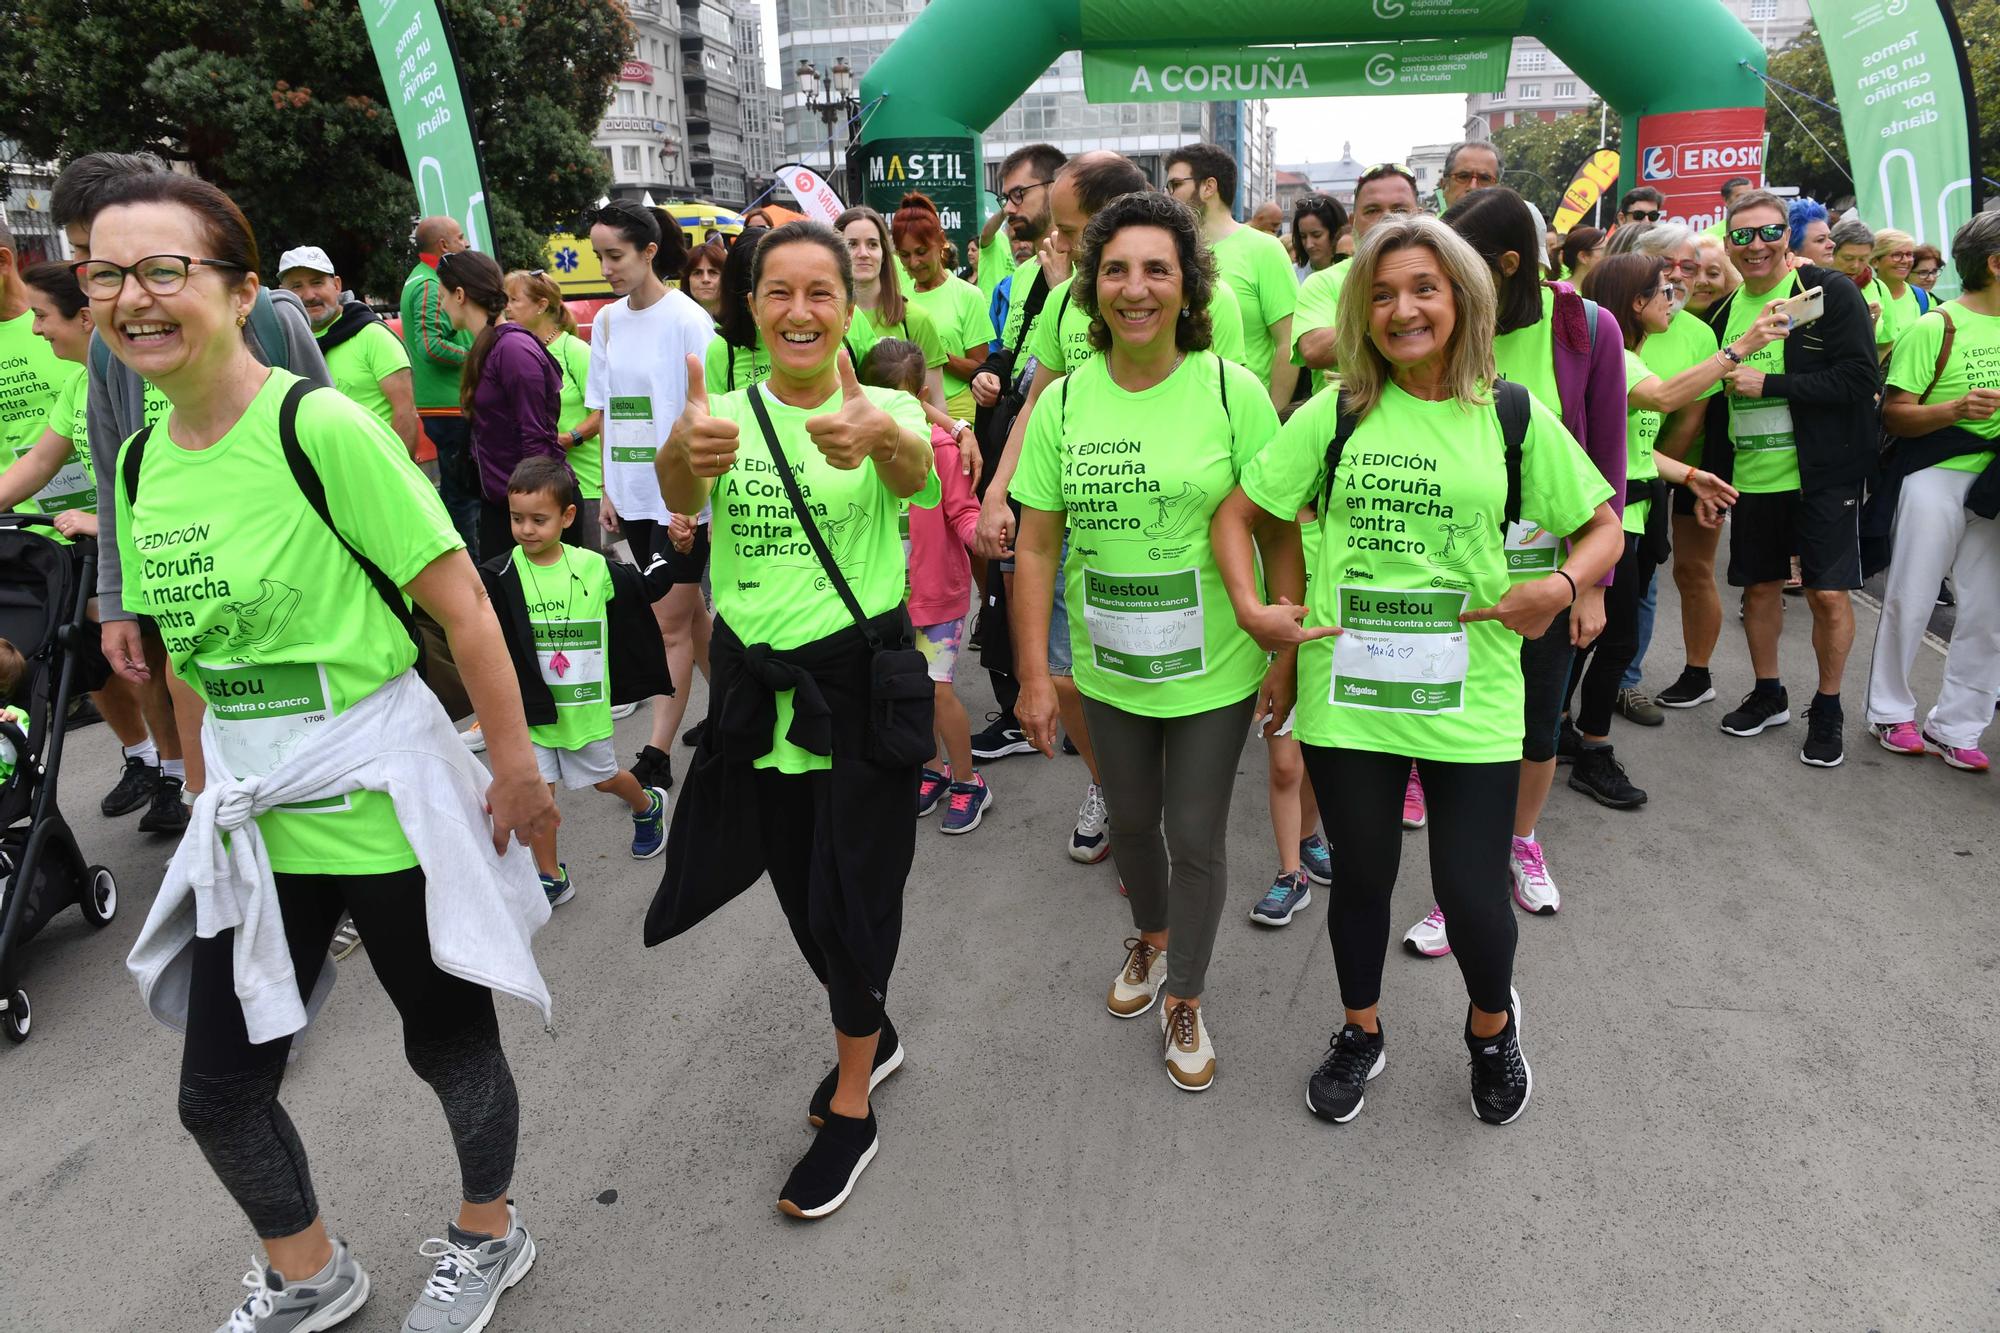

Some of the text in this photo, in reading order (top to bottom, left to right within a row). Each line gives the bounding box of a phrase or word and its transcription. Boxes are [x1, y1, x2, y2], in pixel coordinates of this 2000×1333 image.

[1410, 8, 1439, 16] contra
[1401, 51, 1488, 63] asociación española
[1130, 56, 1310, 94] A CORUÑA
[1400, 64, 1429, 72] contra
[1436, 63, 1467, 71] cancro
[1420, 72, 1452, 81] Coruña
[1683, 145, 1763, 171] EROSKI
[869, 153, 967, 182] MASTIL
[1073, 348, 1093, 360] Cor
[1743, 351, 1772, 363] rcha
[1962, 350, 1970, 359] X
[0, 356, 29, 370] CIÓN
[1965, 362, 1975, 372] A
[0, 370, 37, 386] oruña
[1967, 372, 1985, 381] en
[0, 381, 50, 399] marcha
[0, 399, 28, 411] ntra
[2, 407, 45, 422] cancro
[1067, 438, 1142, 456] X EDICIÓN
[731, 458, 740, 471] X
[1065, 460, 1146, 477] A Coruña
[1349, 453, 1437, 472] X EDICIÓN
[727, 478, 739, 497] A
[1063, 477, 1161, 495] en marcha
[1345, 473, 1442, 498] A Coruña
[728, 501, 828, 520] en marha
[1066, 498, 1118, 513] contra
[1346, 496, 1454, 519] en marcha
[731, 521, 793, 538] contra
[1350, 514, 1406, 533] contra
[141, 522, 210, 550] EDICIÓN
[743, 542, 812, 558] cancro
[1356, 536, 1426, 555] cancro
[144, 551, 215, 580] Coruña
[1344, 567, 1374, 580] Vegalsa
[153, 576, 232, 605] marcha
[1090, 577, 1159, 597] Eu estou
[526, 599, 565, 615] DICIÓN
[1091, 595, 1099, 603] en
[1099, 597, 1125, 607] marcha
[1125, 599, 1152, 608] contra
[1160, 597, 1189, 606] cancro
[1349, 595, 1433, 616] Eu estou
[1183, 609, 1197, 618] 1701
[1358, 617, 1392, 627] marcha
[1393, 619, 1424, 628] contra
[1433, 620, 1453, 628] cancro
[166, 624, 230, 654] cancro
[547, 627, 583, 639] estou
[1366, 643, 1395, 659] MARÍA
[205, 678, 265, 698] estou
[1343, 683, 1378, 696] Vegalsa
[221, 702, 257, 713] contra
[268, 696, 310, 710] cancro
[303, 714, 325, 724] 1706
